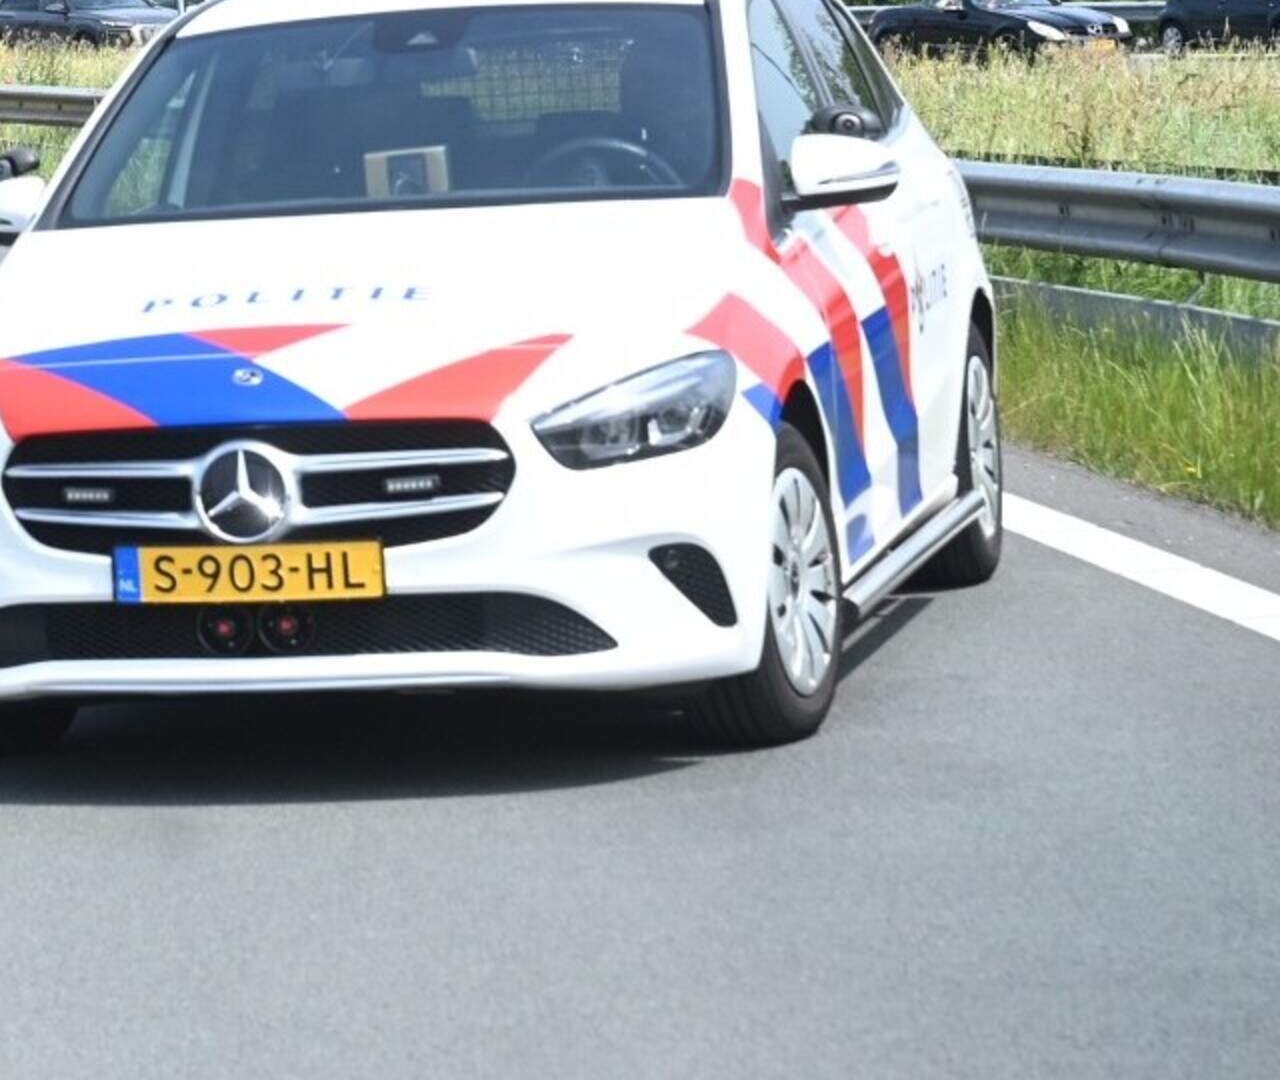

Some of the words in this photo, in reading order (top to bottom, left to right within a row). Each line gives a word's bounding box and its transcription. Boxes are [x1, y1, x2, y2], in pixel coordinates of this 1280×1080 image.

[142, 286, 431, 314] POLITIE
[119, 578, 138, 593] NL
[153, 551, 366, 594] S-903-HL
